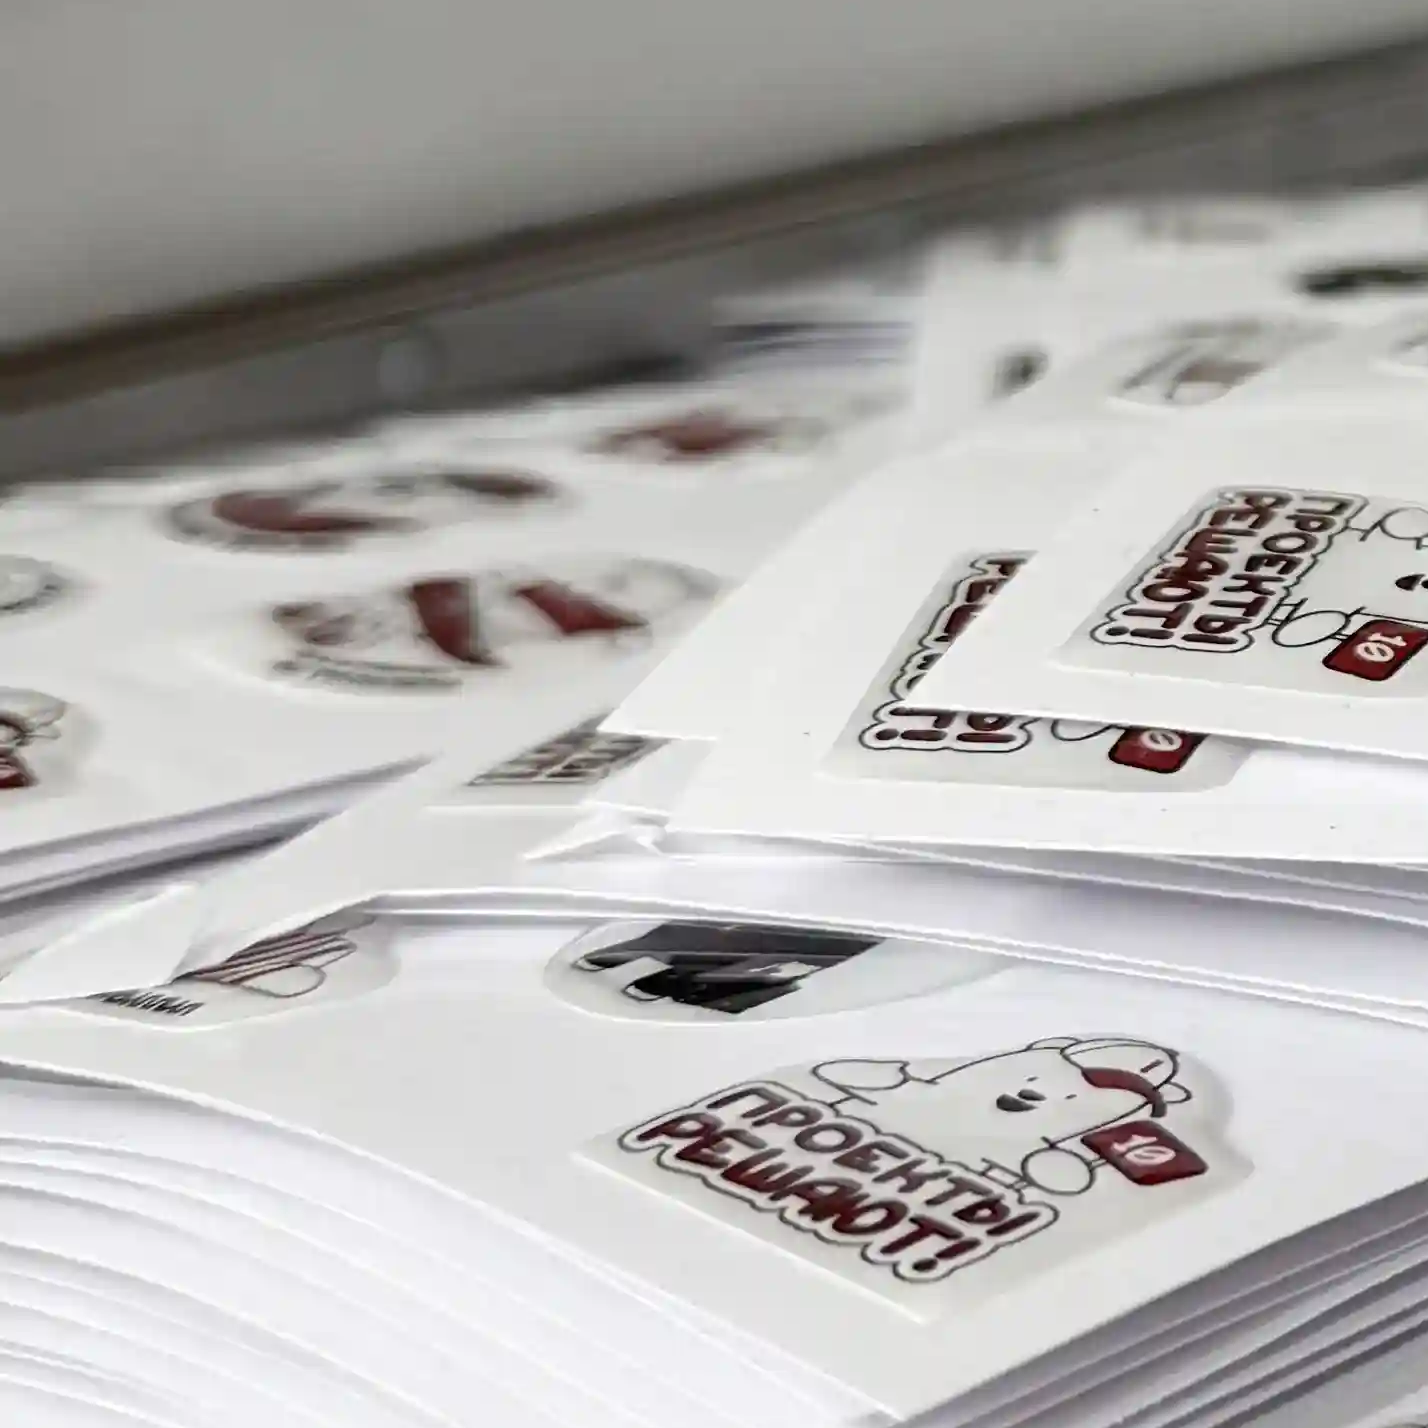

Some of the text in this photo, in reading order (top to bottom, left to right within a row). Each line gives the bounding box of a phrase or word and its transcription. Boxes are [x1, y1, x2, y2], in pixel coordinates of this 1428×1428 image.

[1105, 491, 1294, 641] РЕШАЮТ!
[1181, 495, 1354, 646] ПРОЕКТЫ
[635, 1113, 985, 1272] РЕШАЮТ!
[704, 1087, 1040, 1234] ПРОЕКТЫ
